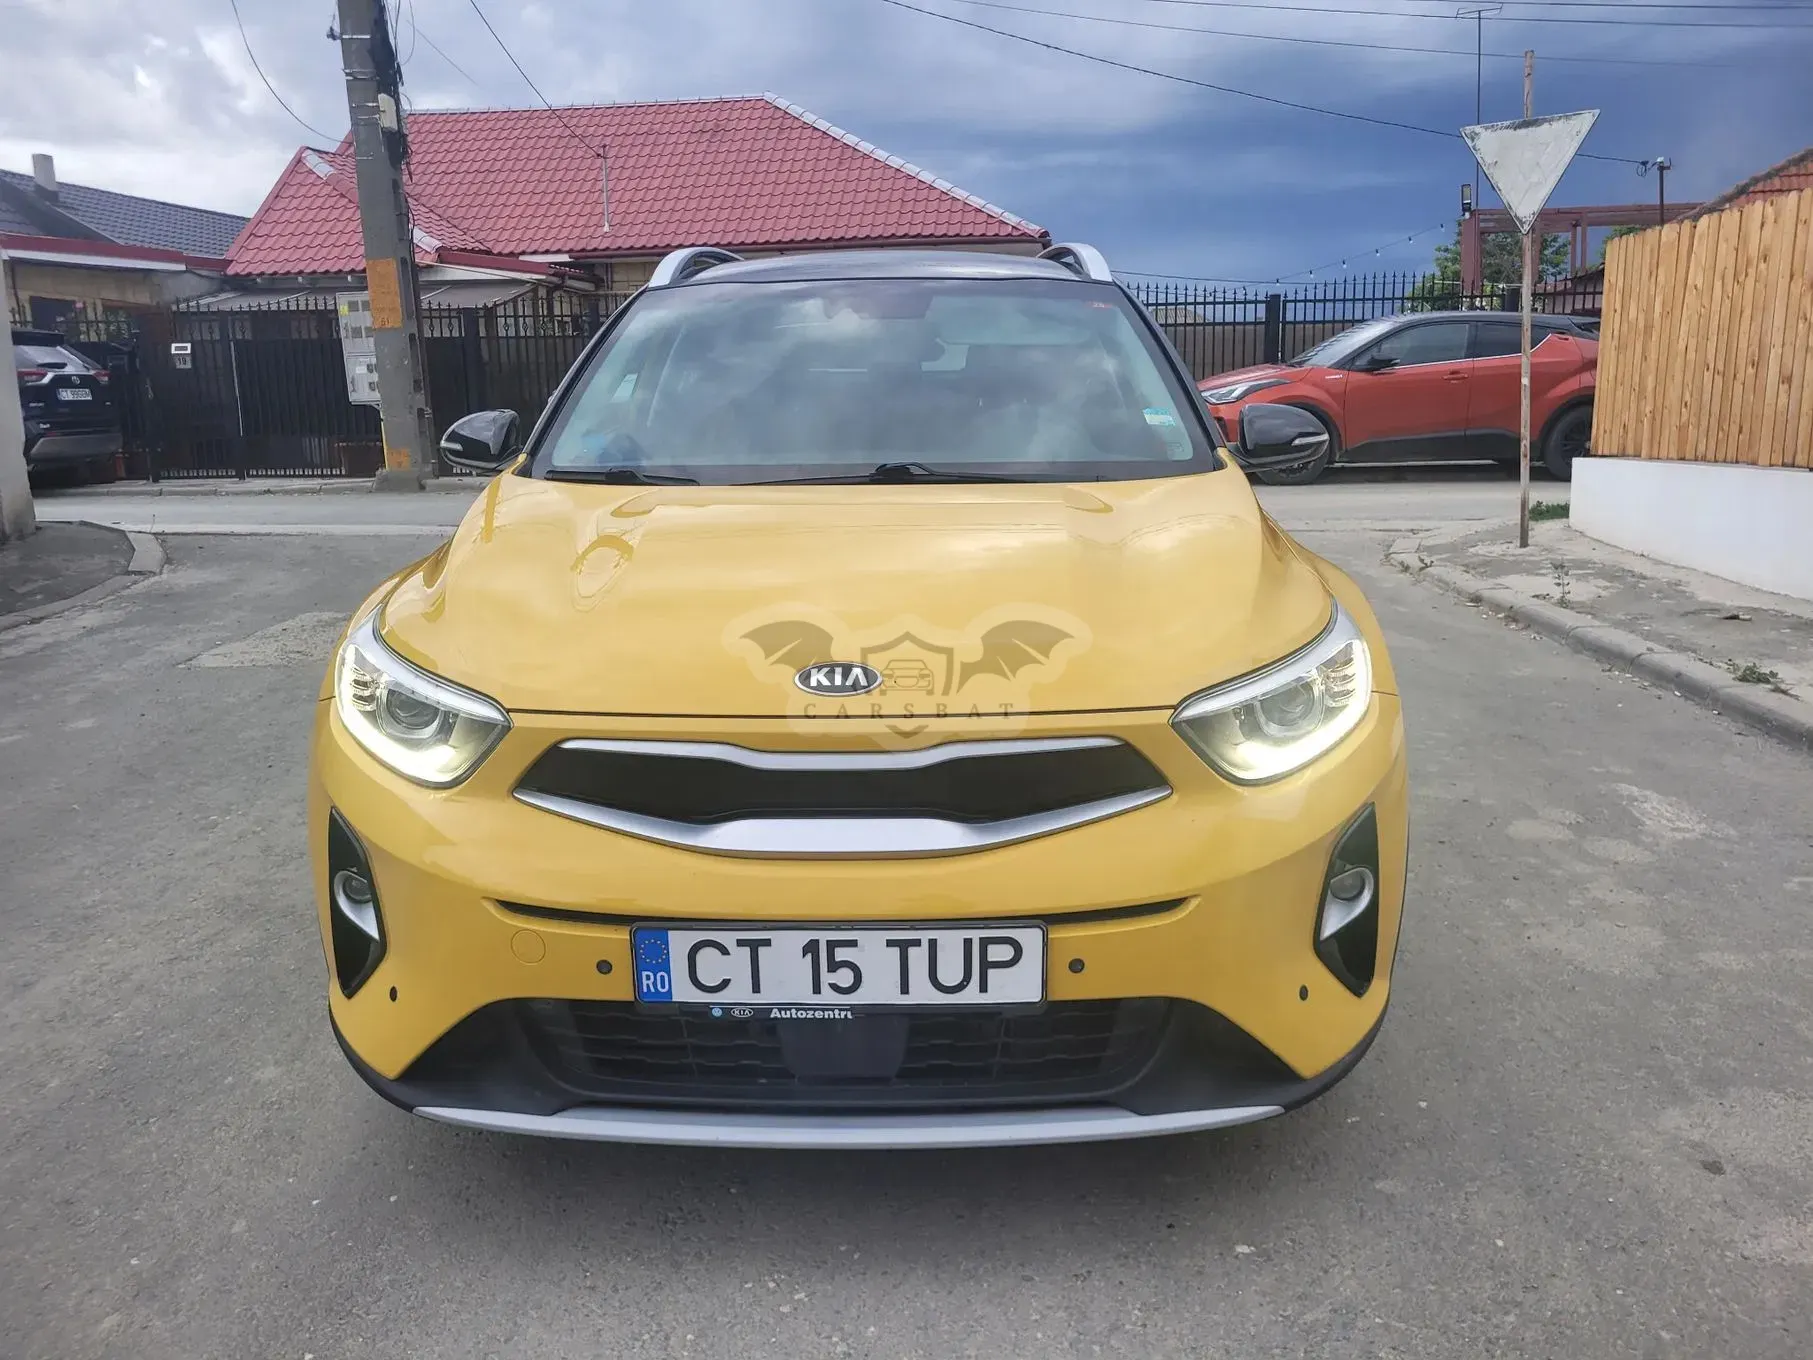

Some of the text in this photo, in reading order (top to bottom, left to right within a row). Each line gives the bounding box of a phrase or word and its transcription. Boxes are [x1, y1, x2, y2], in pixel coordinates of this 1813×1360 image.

[810, 667, 868, 687] KIA
[687, 936, 1024, 995] CT 15 TUP
[642, 971, 669, 992] RO
